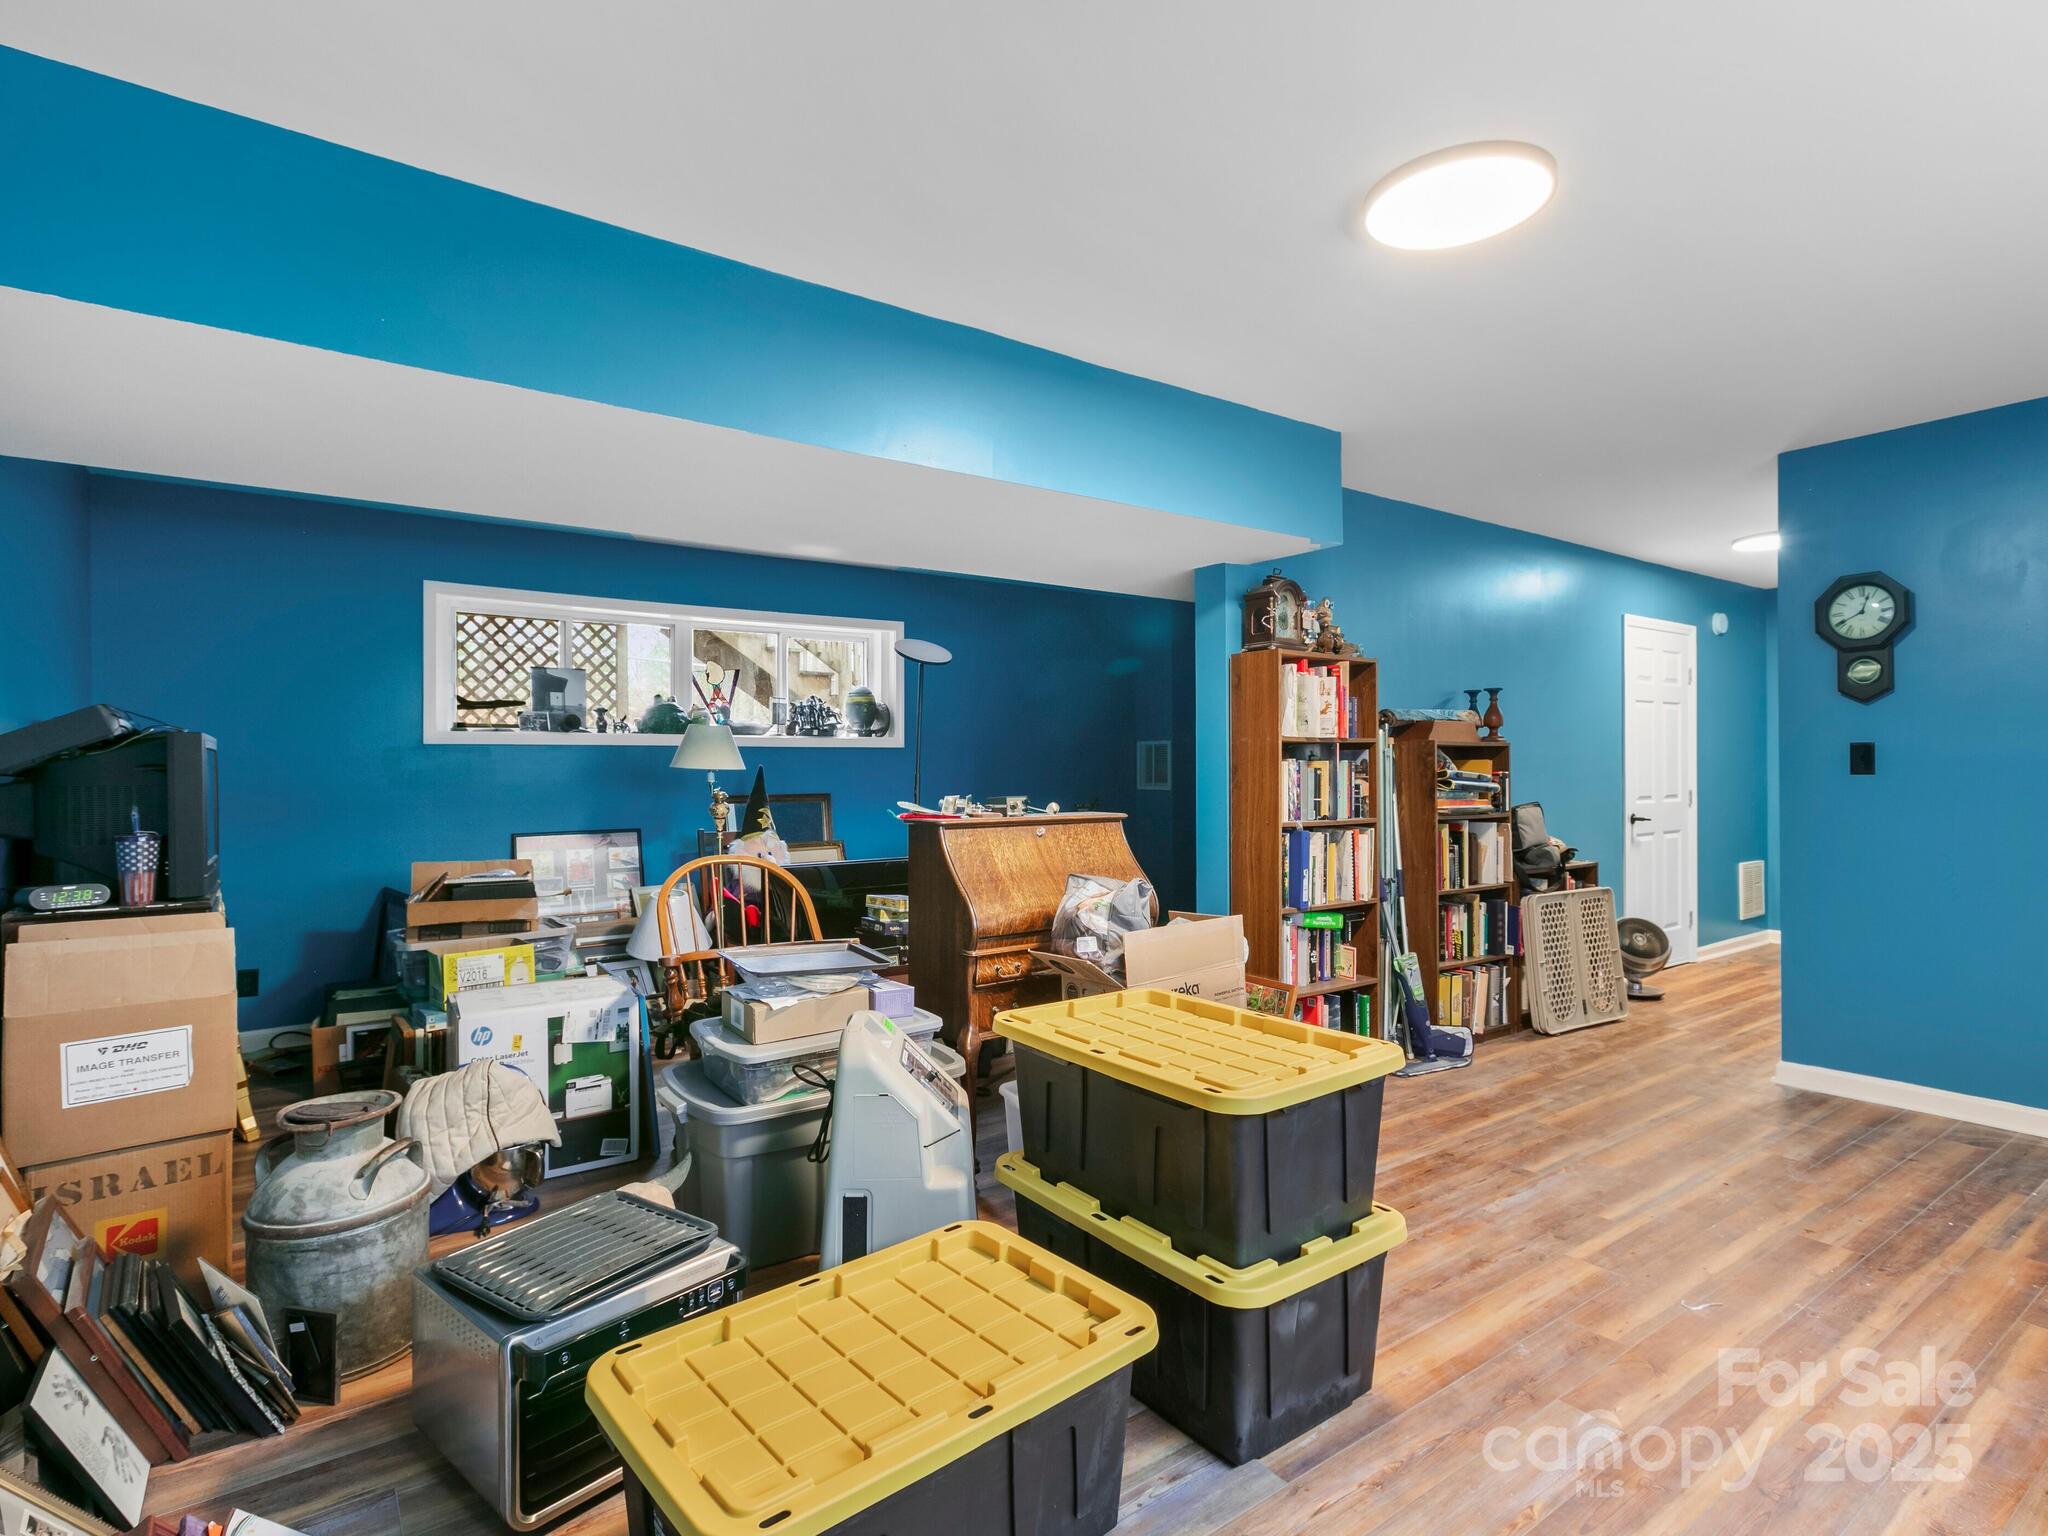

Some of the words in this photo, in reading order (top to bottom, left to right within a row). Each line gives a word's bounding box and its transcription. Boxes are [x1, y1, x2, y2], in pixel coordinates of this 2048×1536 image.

[52, 889, 92, 902] 12:38
[460, 969, 488, 983] V2016
[471, 1026, 493, 1047] hp
[76, 1060, 116, 1074] IMAGE
[119, 1050, 181, 1067] TRANSFER
[495, 1050, 529, 1061] LaserJet
[31, 1152, 224, 1207] ISRAEL
[118, 1230, 157, 1248] Kodak
